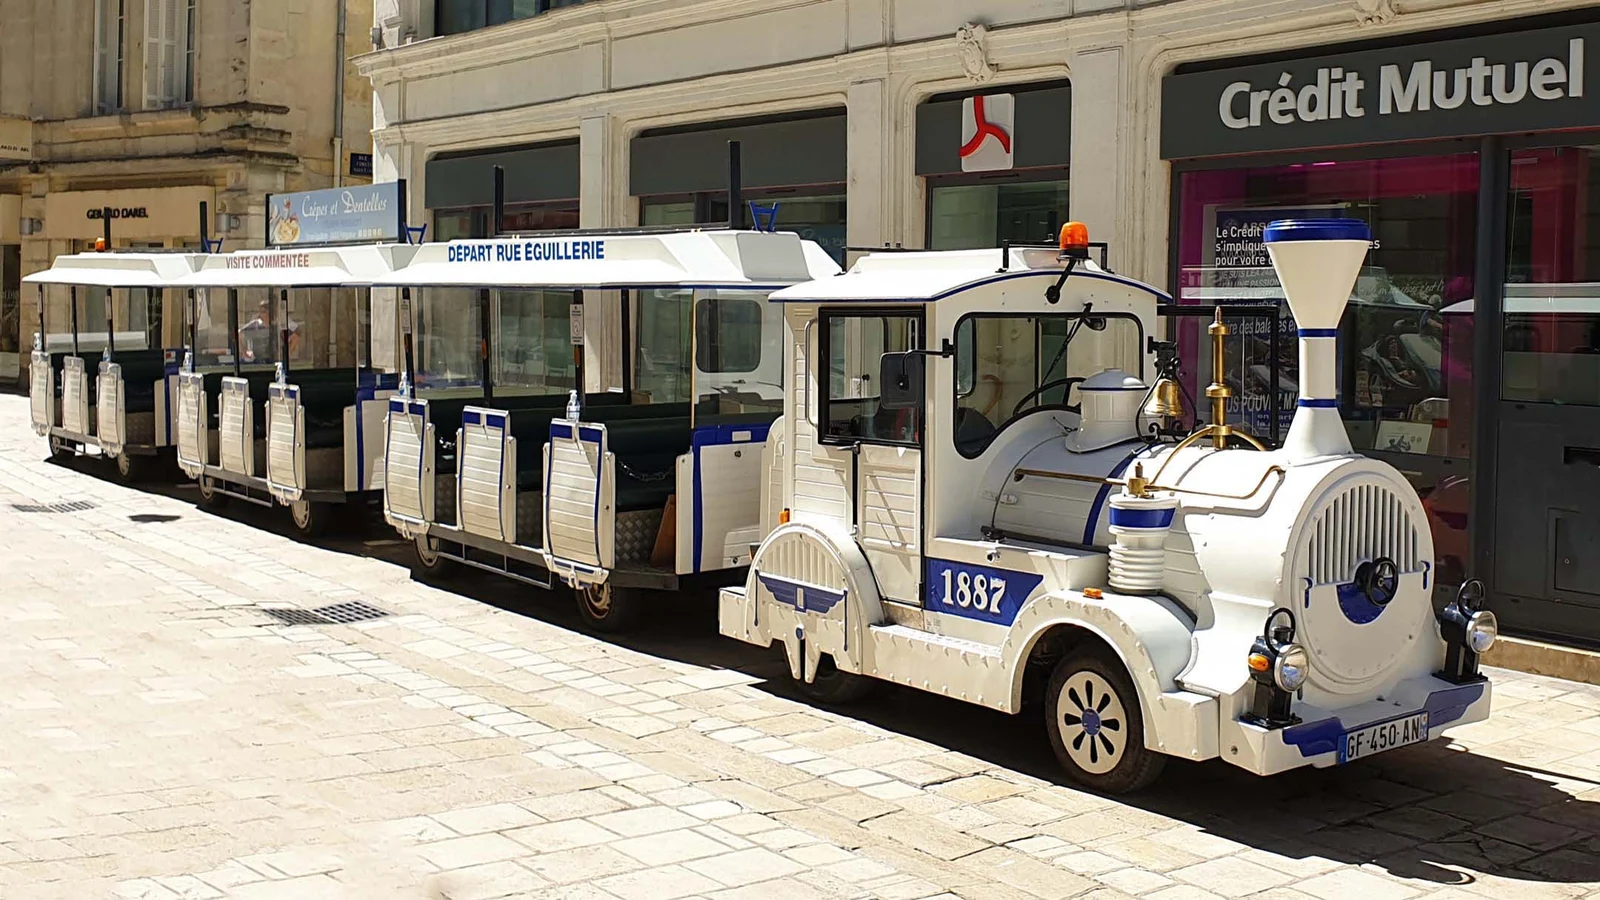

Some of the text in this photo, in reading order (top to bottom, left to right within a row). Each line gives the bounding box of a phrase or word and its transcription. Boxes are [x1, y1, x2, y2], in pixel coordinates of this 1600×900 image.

[1219, 38, 1584, 129] Crédit Mutuel
[330, 200, 339, 215] et
[341, 190, 388, 214] Dentelles
[121, 207, 149, 218] DAREL
[1216, 226, 1229, 238] Le
[448, 241, 605, 262] DÉPART RUE ÉGUILLERIE
[226, 253, 310, 269] VISITE COMMENTÉE
[1215, 257, 1238, 268] pour
[1240, 256, 1266, 266] votre
[1250, 278, 1280, 287] PASSION
[941, 569, 1006, 614] 1887
[1346, 717, 1420, 759] GF-450-AN
